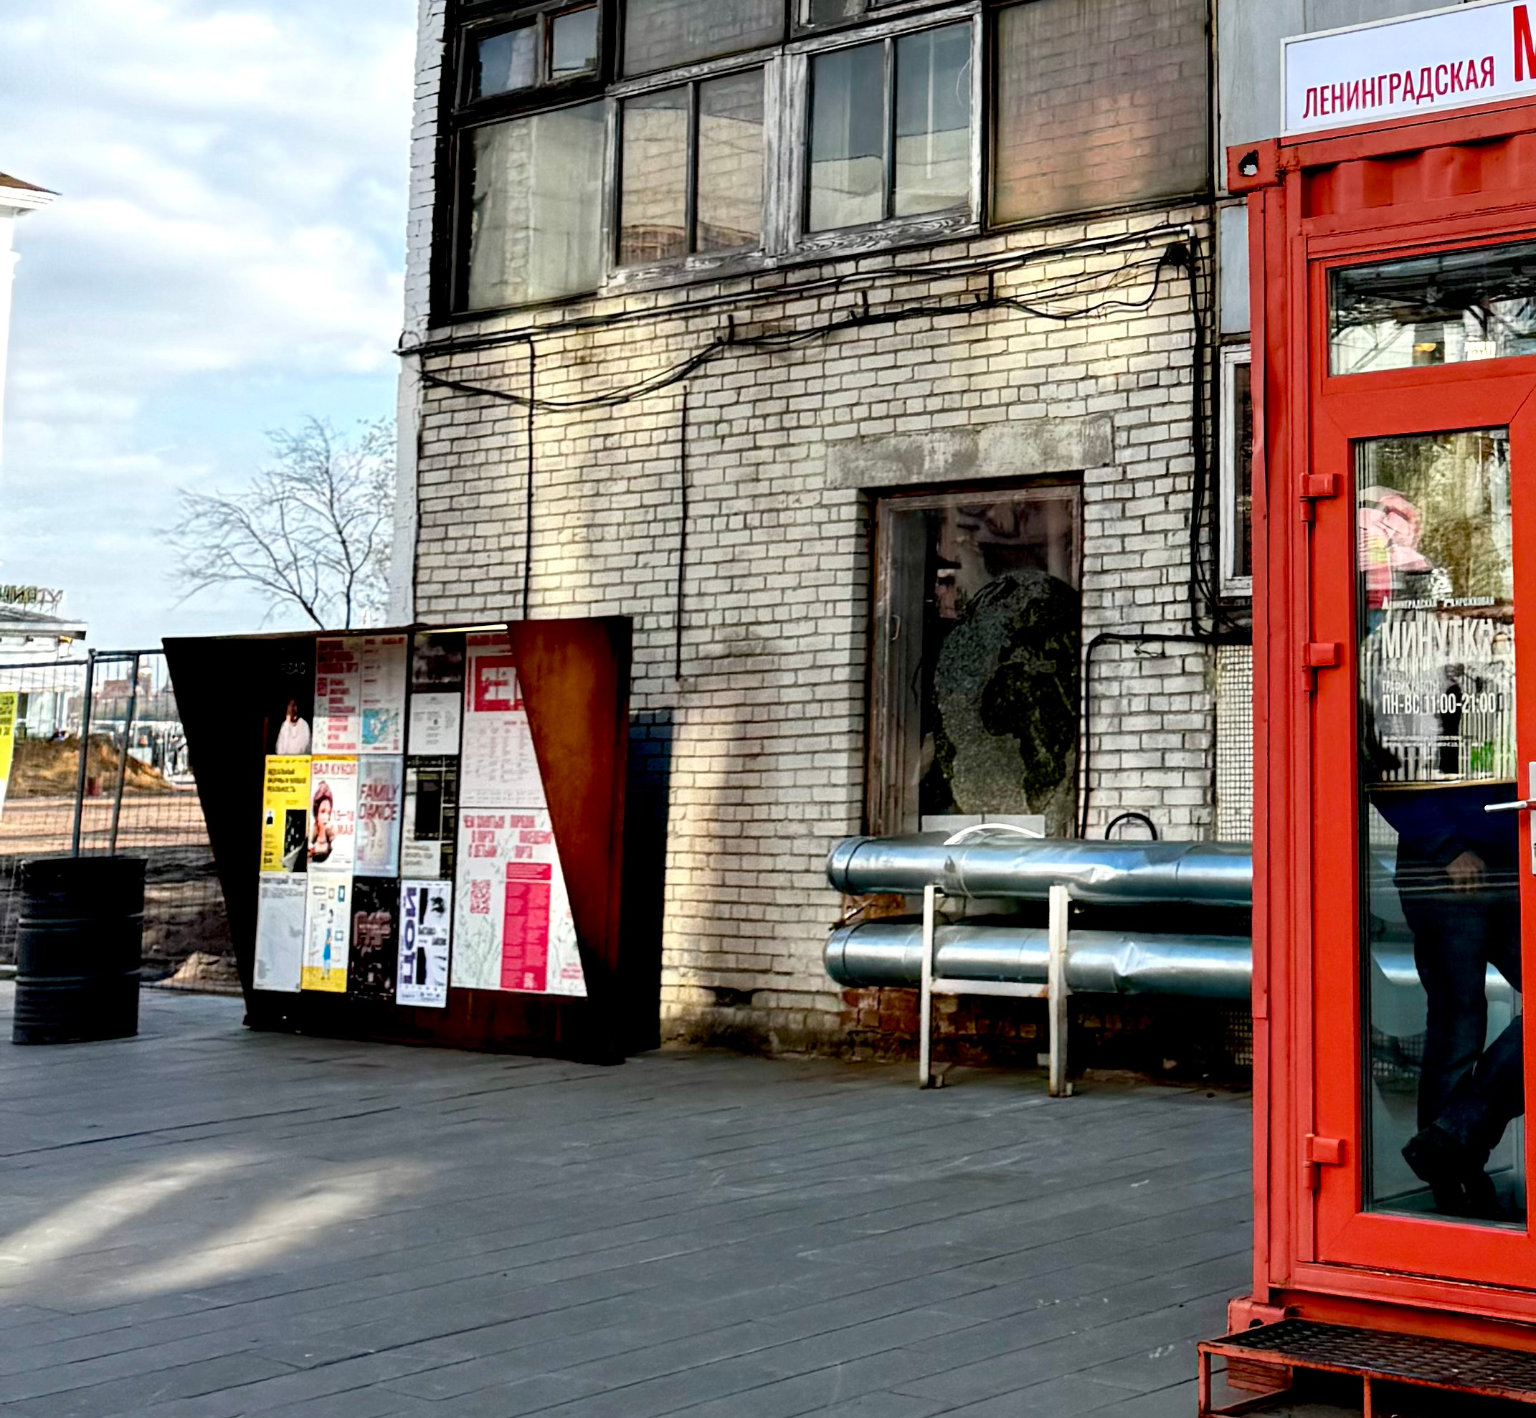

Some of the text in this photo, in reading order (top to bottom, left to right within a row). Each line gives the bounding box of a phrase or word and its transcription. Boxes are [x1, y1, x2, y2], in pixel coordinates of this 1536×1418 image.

[1302, 55, 1496, 119] ЛЕНИНГРАДСКАЯ
[1382, 617, 1493, 660] МИНУТКА
[1382, 692, 1497, 715] ПН-ВС 11:00-21:00
[360, 784, 399, 802] FAMILY
[358, 803, 398, 821] DANCE
